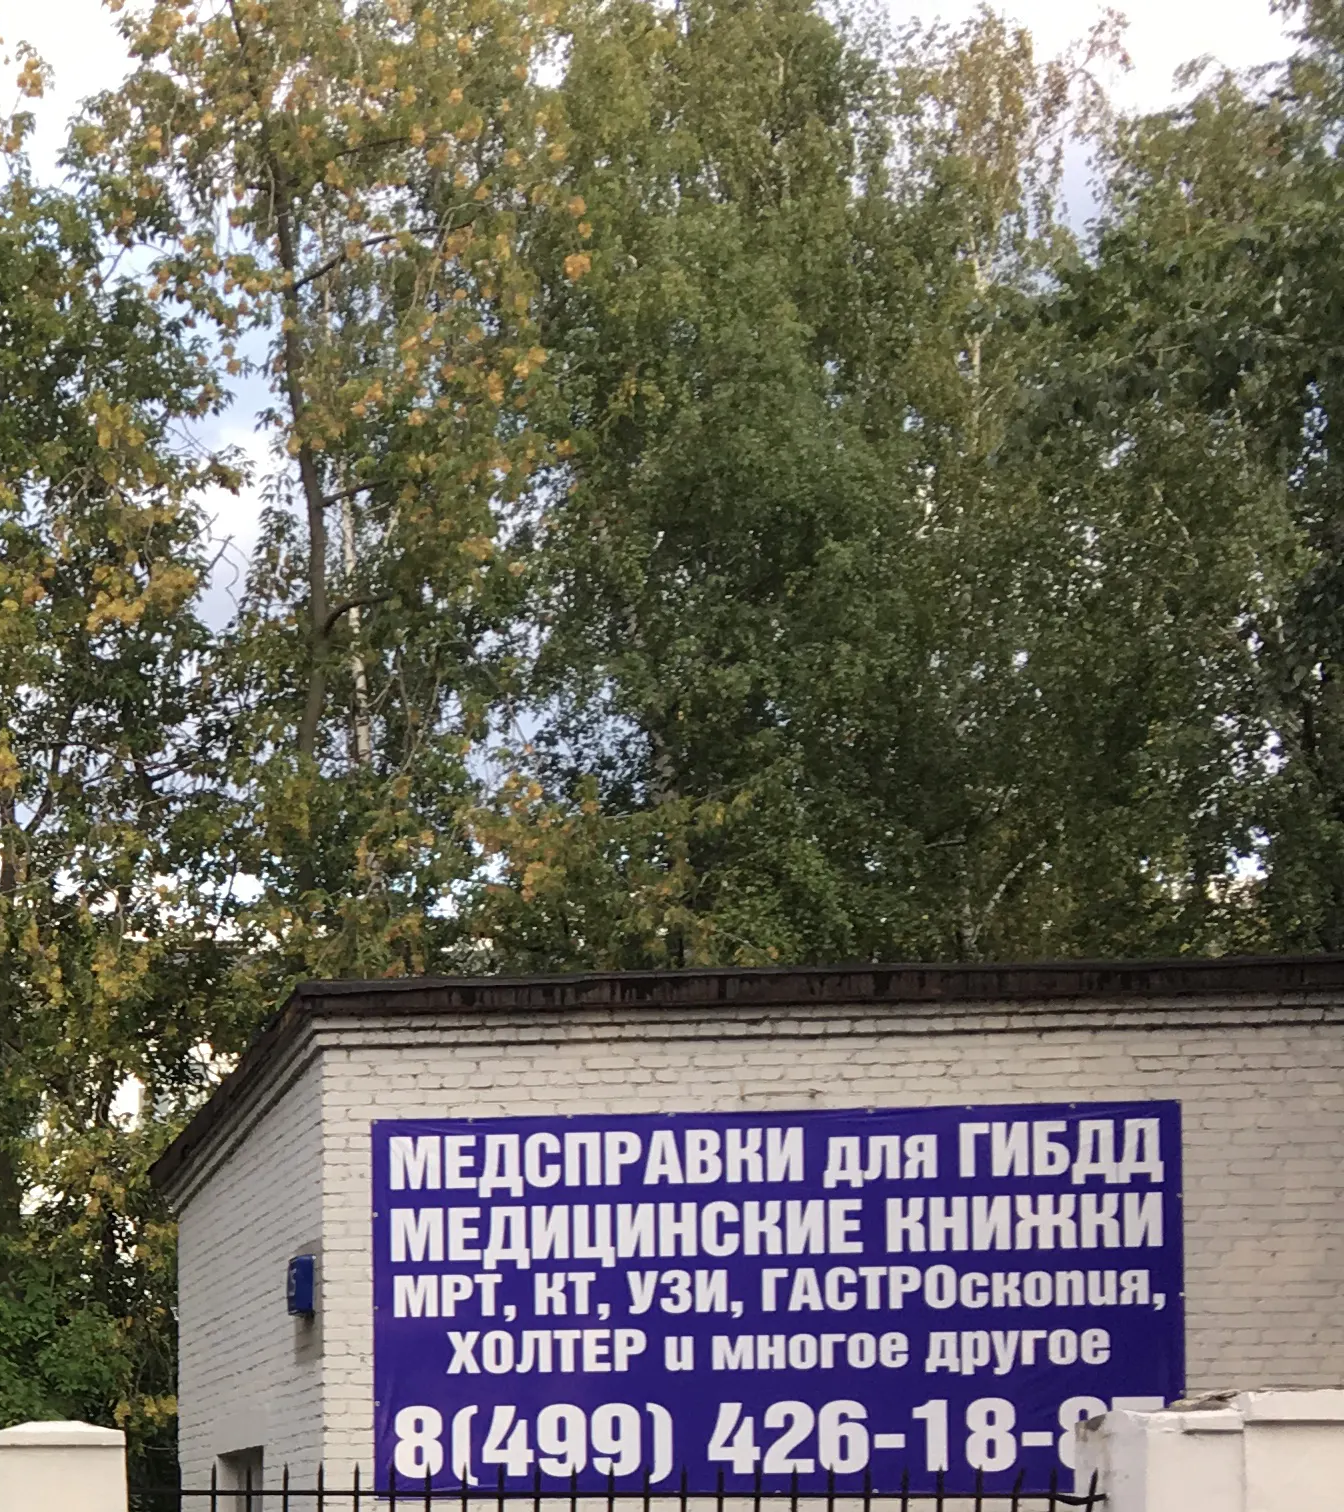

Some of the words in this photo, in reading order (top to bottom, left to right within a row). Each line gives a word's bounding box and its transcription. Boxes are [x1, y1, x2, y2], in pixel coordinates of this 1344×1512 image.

[390, 1127, 804, 1197] МЕДСПРАВКИ
[824, 1135, 937, 1188] для
[960, 1118, 1163, 1184] ГИБДД
[391, 1198, 863, 1270] МЕДИЦИНСКИЕ
[887, 1192, 1162, 1253] КНИЖКИ
[394, 1273, 516, 1321] МРТ,
[535, 1272, 610, 1320] КТ,
[627, 1270, 743, 1318] УЗИ,
[762, 1265, 1165, 1313] ГАСТРОскопия,
[447, 1329, 646, 1374] ХОЛТЕР
[665, 1336, 693, 1371] и
[712, 1332, 908, 1370] многое
[926, 1329, 1110, 1375] другое
[394, 1403, 672, 1486] 8(499)
[708, 1396, 1164, 1474] 426-18-8
